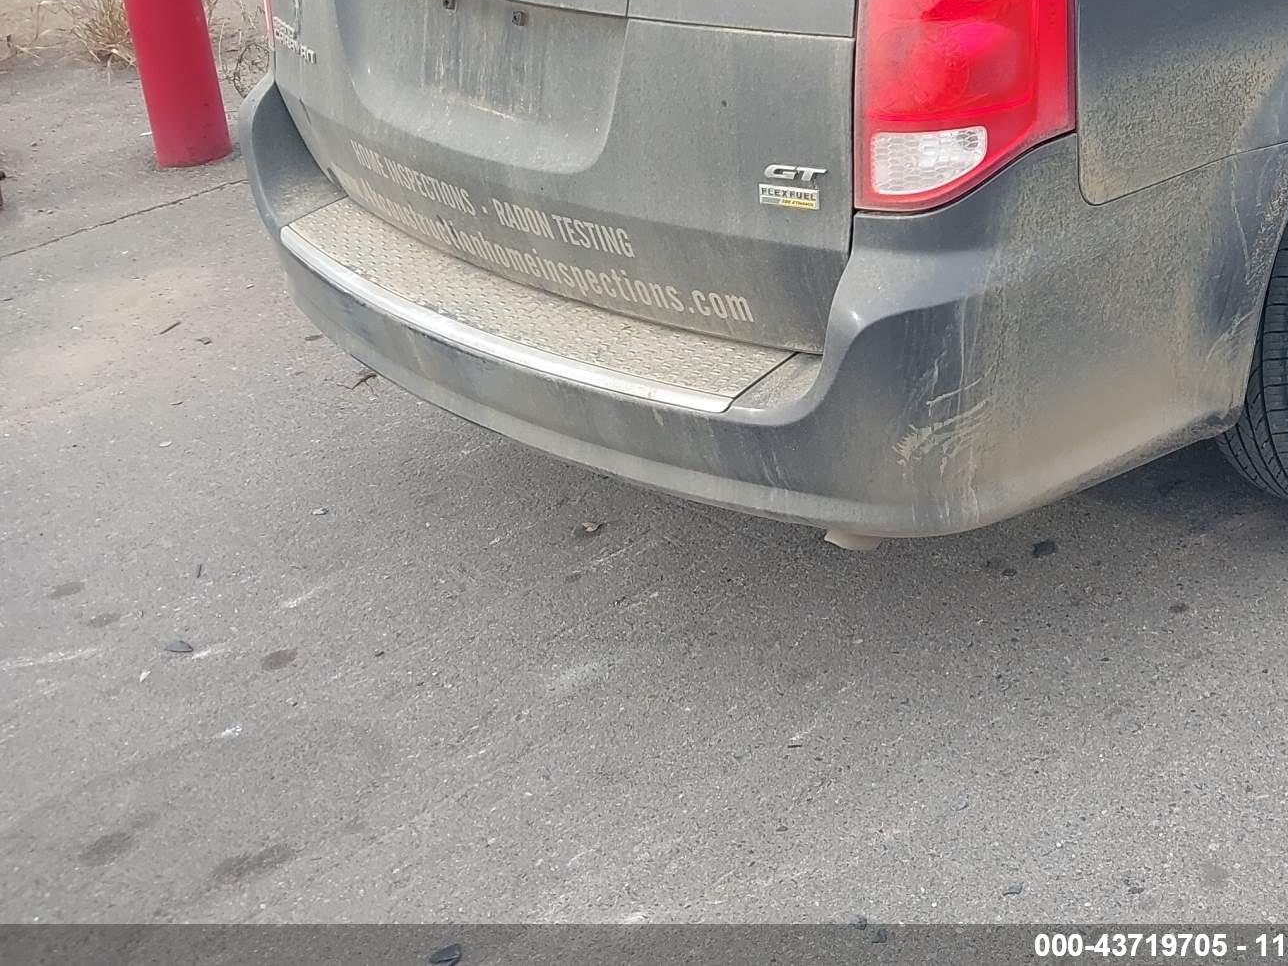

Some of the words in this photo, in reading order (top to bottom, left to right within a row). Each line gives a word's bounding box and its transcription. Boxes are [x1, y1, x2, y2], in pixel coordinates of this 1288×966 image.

[350, 138, 389, 179] HOME
[383, 156, 477, 216] INSPECTIONS
[491, 197, 555, 240] RADON
[551, 214, 636, 259] TESTING
[763, 163, 828, 182] GT
